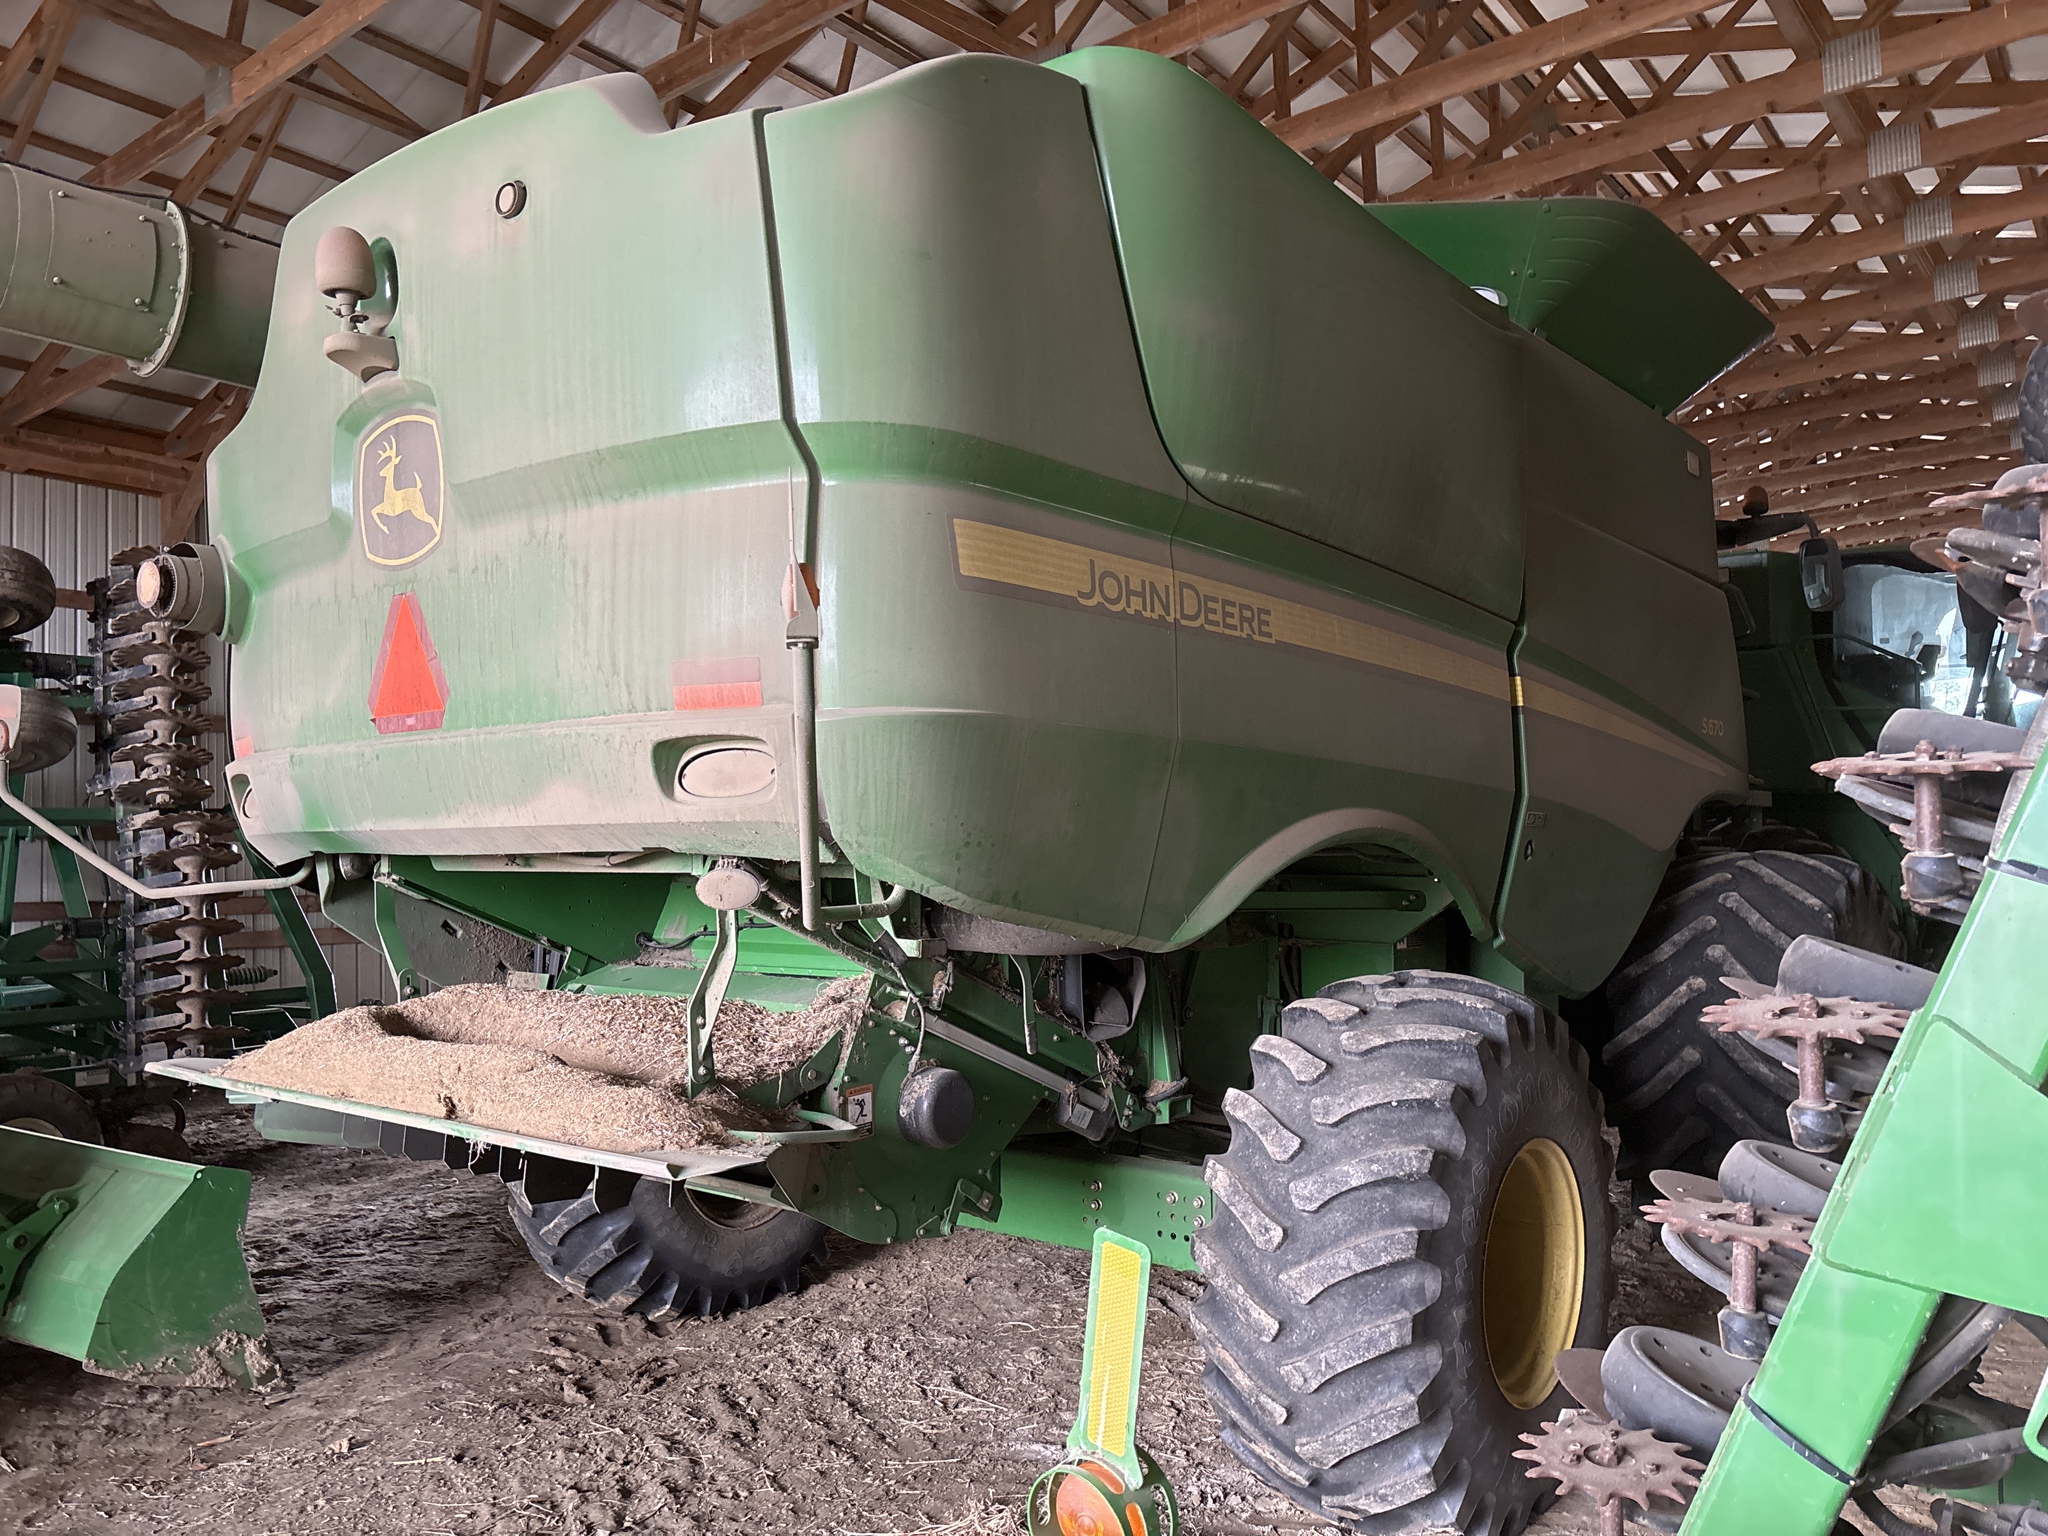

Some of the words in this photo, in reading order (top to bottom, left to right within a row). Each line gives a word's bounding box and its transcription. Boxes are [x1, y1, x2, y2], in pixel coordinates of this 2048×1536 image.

[1077, 558, 1172, 617] JOHN
[1178, 580, 1274, 639] DEERE
[1702, 717, 1724, 737] S670
